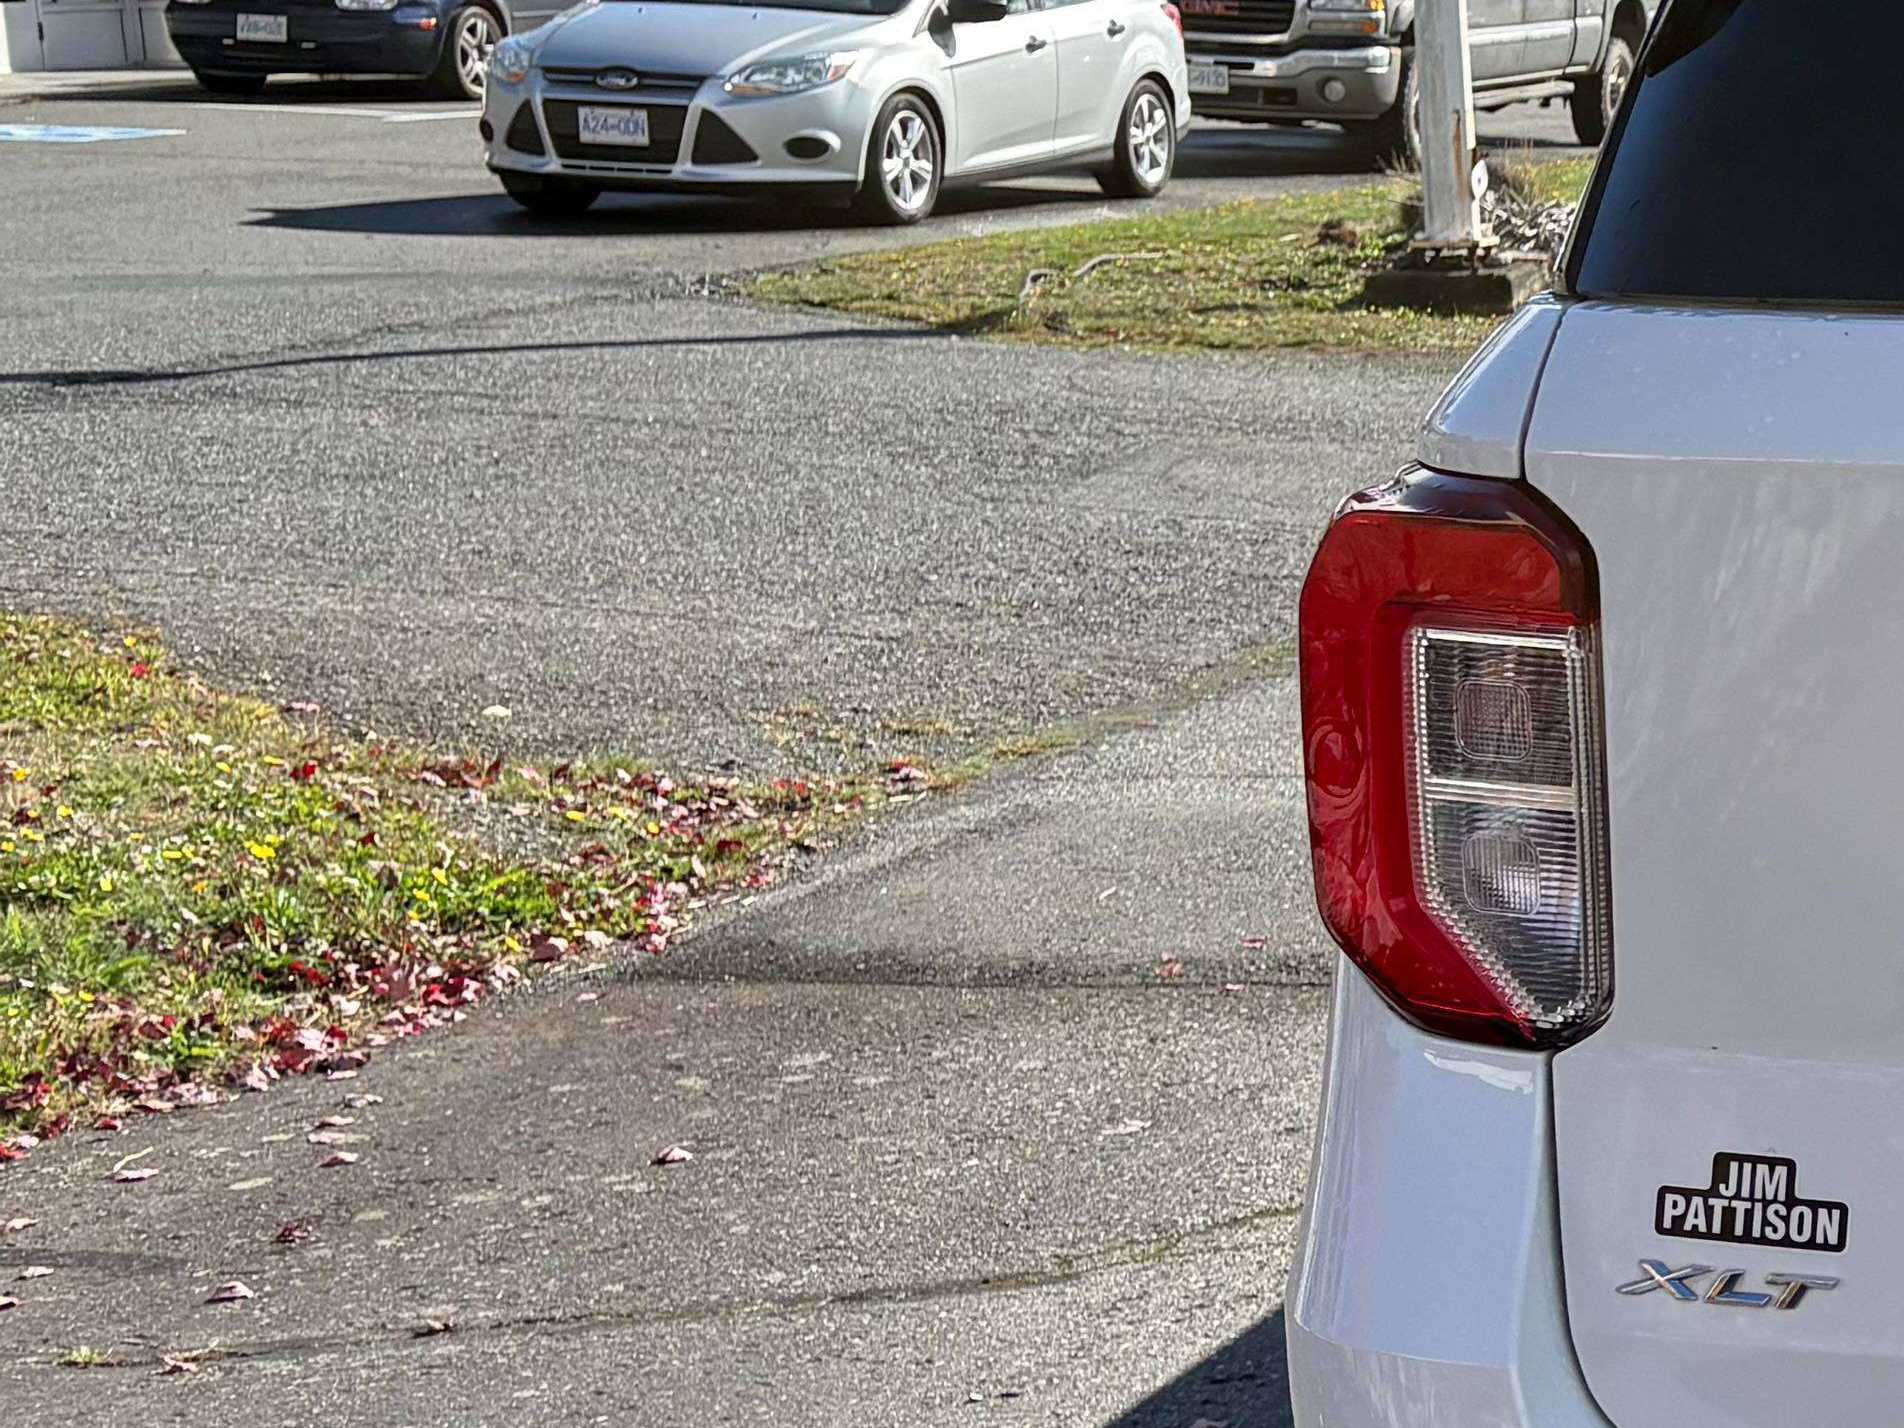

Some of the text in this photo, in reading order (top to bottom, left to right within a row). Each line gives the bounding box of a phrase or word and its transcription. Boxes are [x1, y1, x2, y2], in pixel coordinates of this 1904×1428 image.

[1718, 1160, 1789, 1202] JIM
[1662, 1192, 1841, 1246] PATTISON
[1615, 1258, 1841, 1310] XLT
